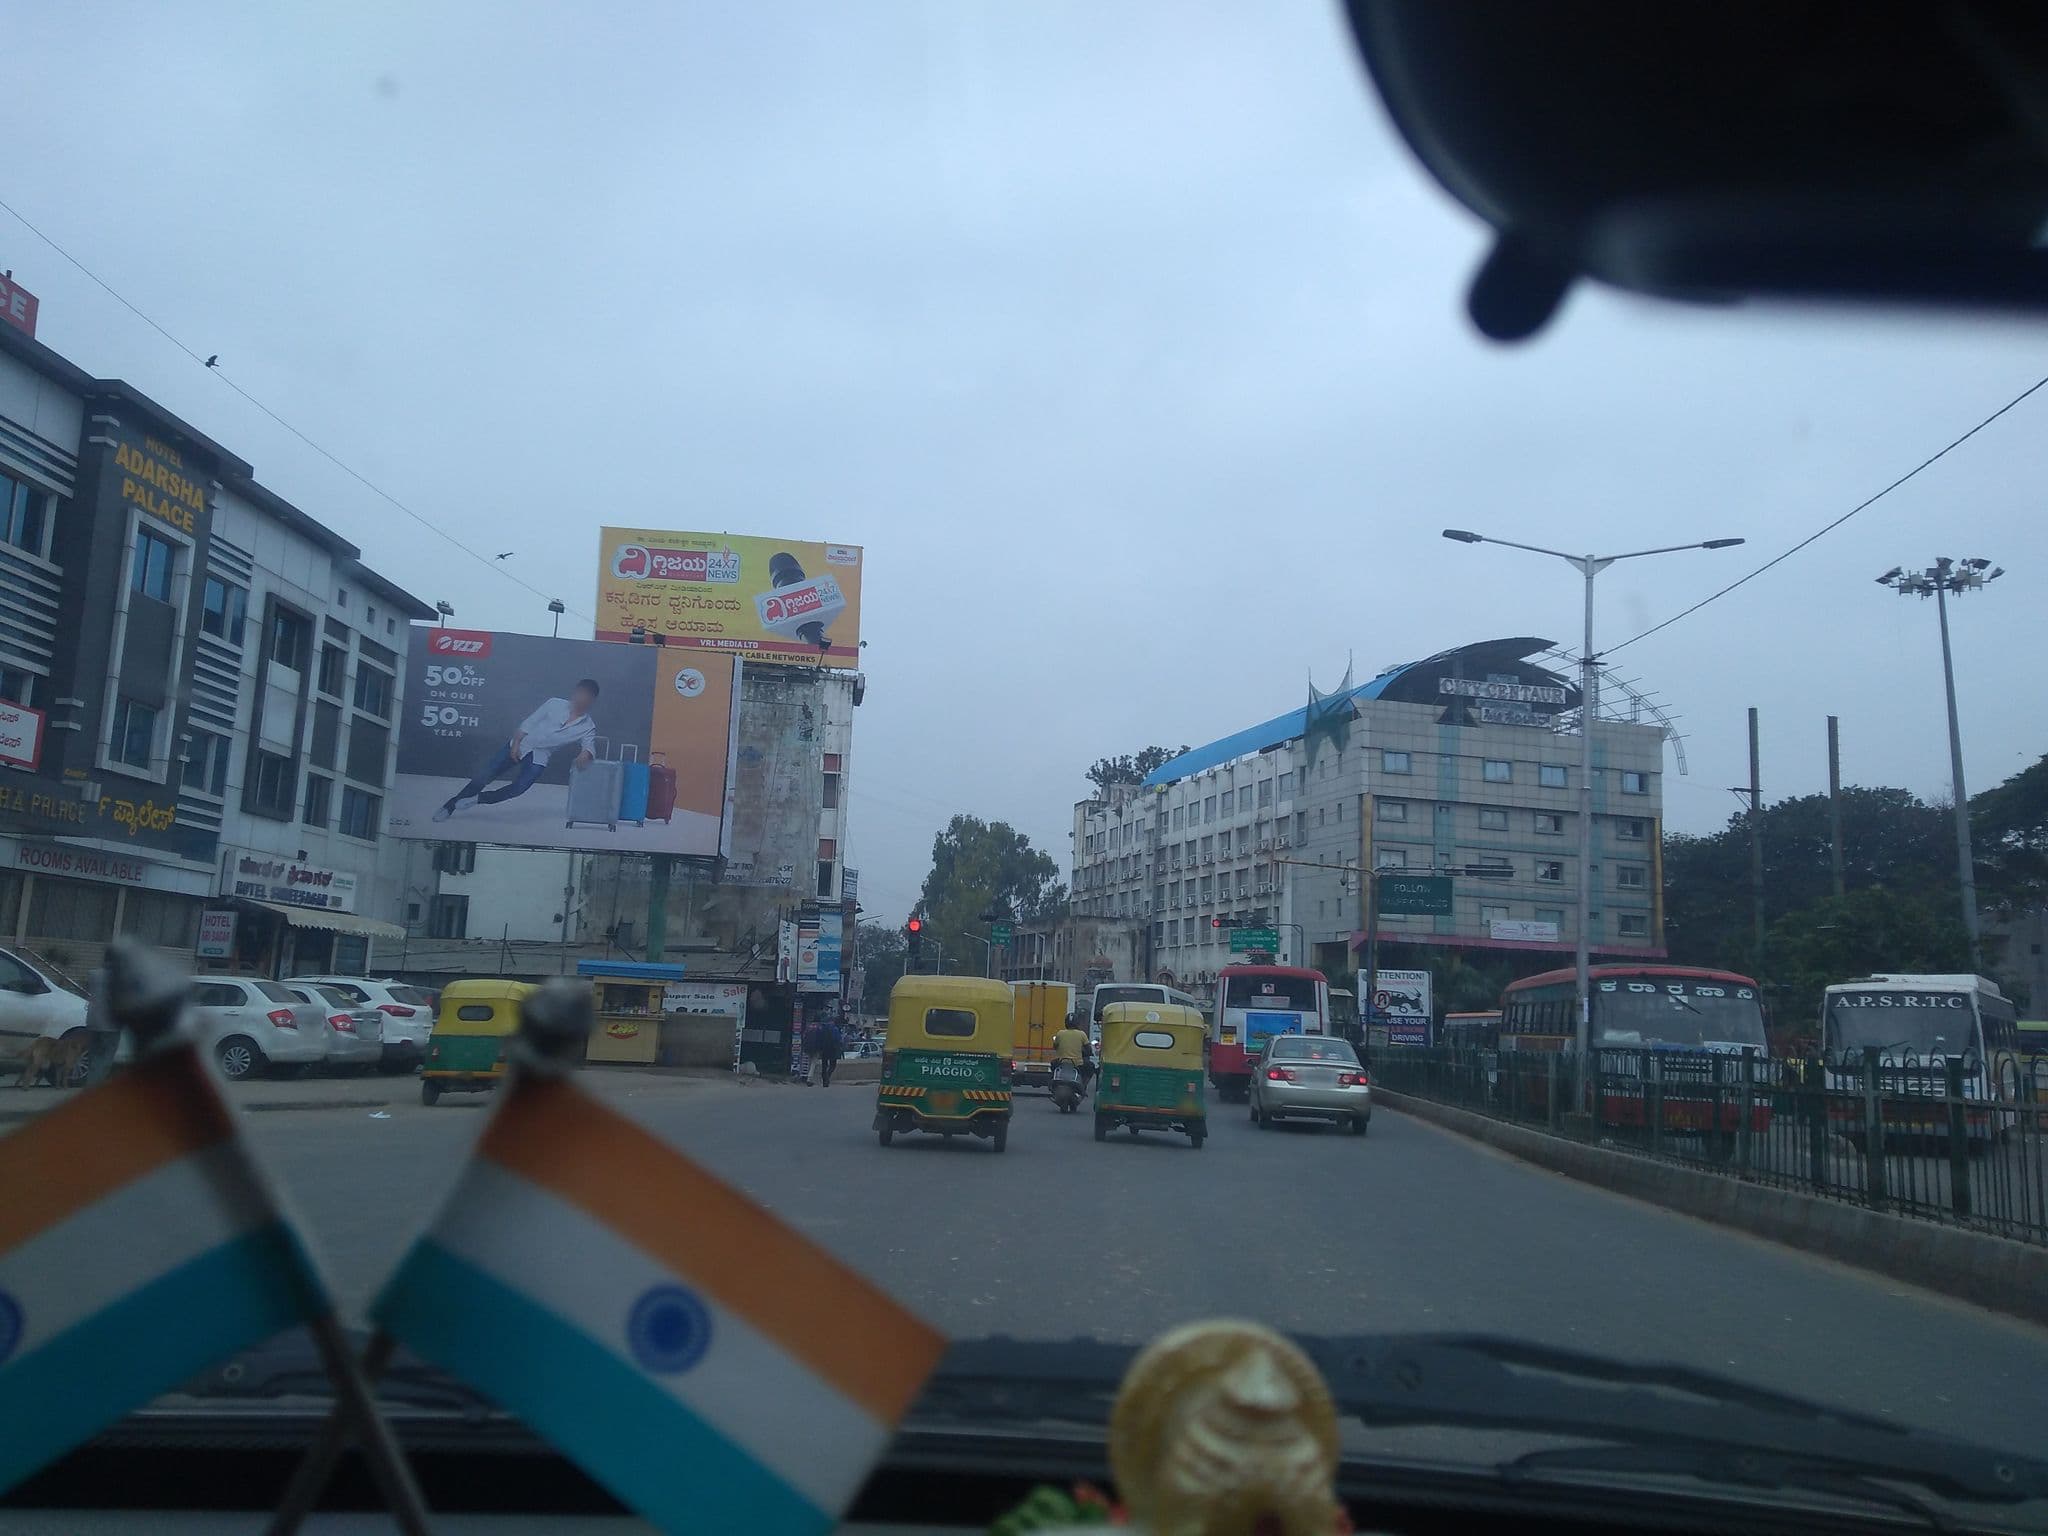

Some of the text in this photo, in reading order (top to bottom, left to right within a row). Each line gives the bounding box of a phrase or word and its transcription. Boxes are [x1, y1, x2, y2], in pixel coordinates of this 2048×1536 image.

[145, 435, 183, 469] HOTEL
[115, 442, 205, 513] ADARSHA
[122, 478, 195, 533] PALACE
[708, 570, 737, 579] NEWS
[700, 639, 717, 647] VRL
[746, 653, 772, 661] CABLE
[773, 654, 816, 663] NETWORKS
[461, 677, 486, 687] OFF
[451, 692, 475, 701] OUR
[434, 729, 463, 738] YEAR
[32, 793, 88, 824] PALACE
[20, 847, 144, 882] ROOMS AVAILABLE
[205, 915, 230, 927] HOTEL
[723, 985, 747, 997] Sale
[1392, 1034, 1424, 1042] DRIVING
[921, 1066, 972, 1078] PIAGGIO
